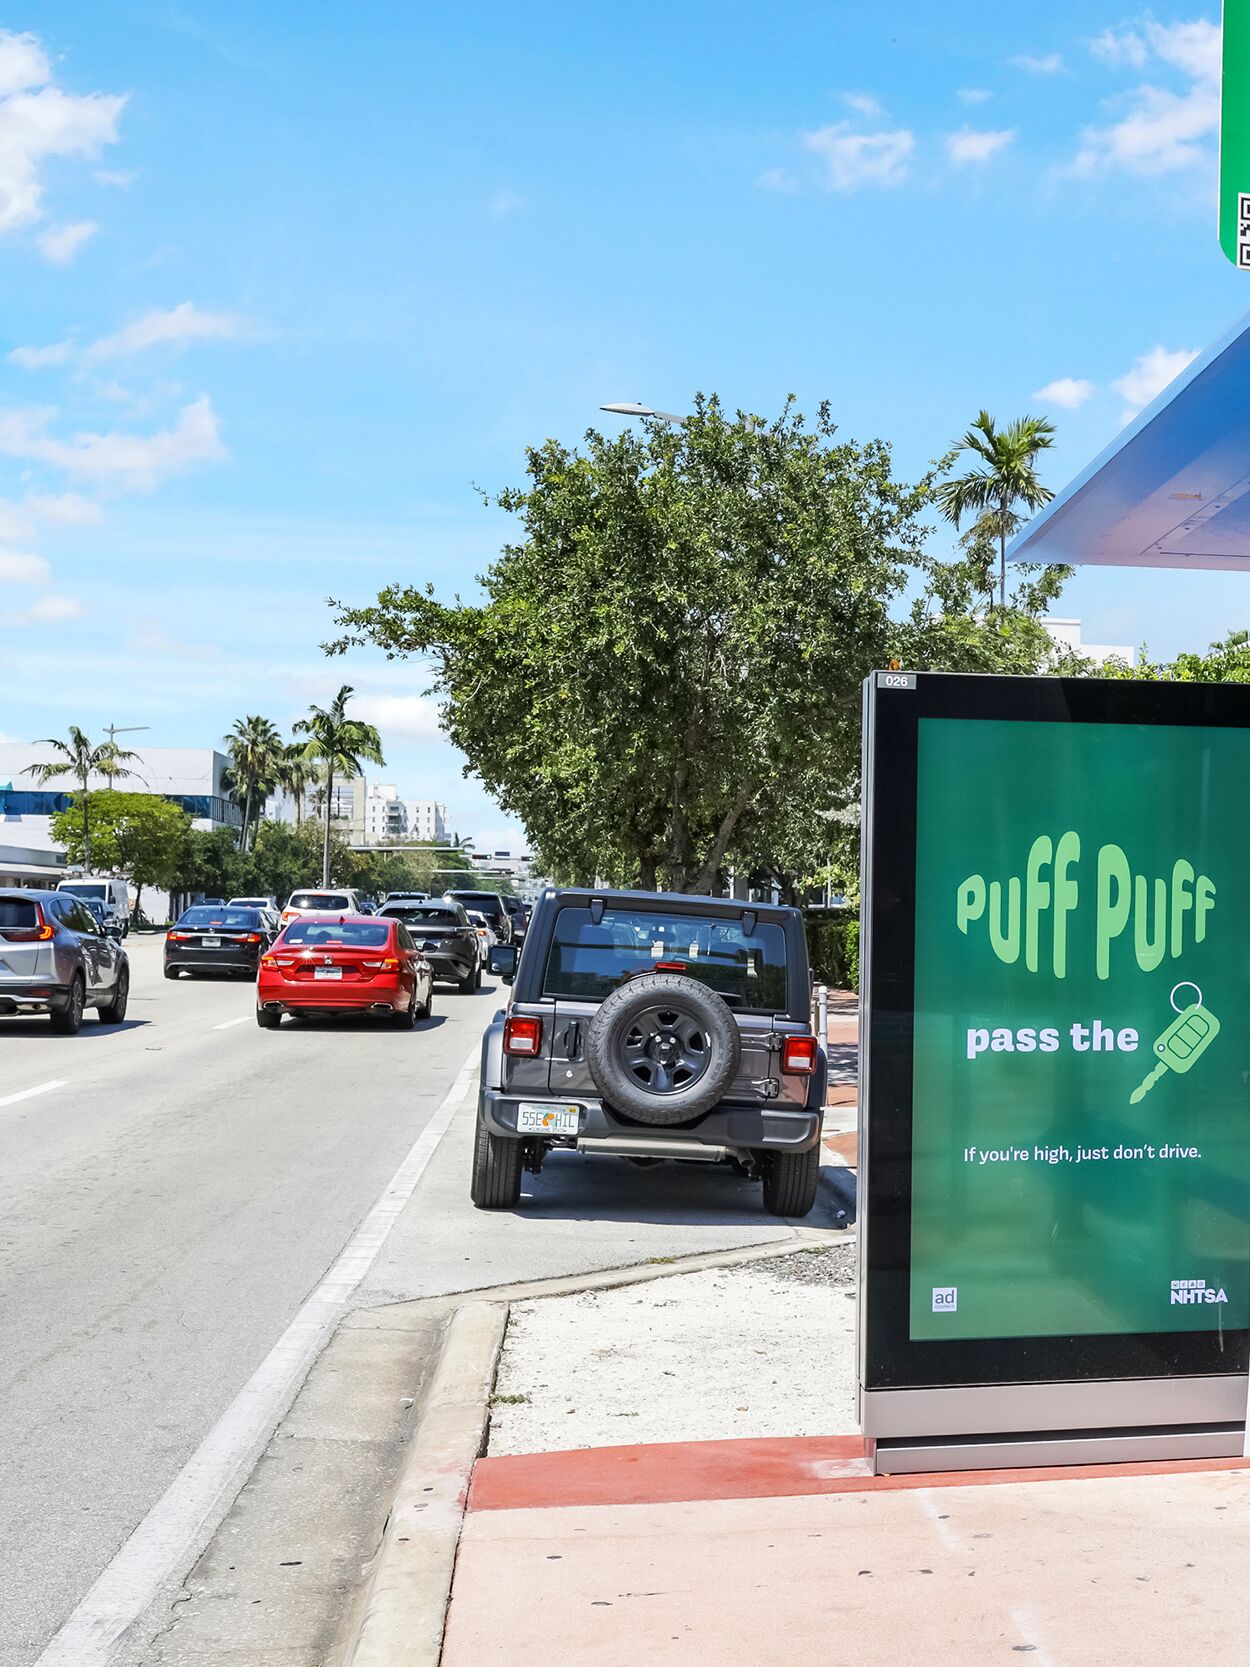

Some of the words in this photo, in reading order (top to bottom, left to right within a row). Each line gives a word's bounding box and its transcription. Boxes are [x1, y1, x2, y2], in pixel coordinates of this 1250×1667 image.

[885, 675, 908, 687] 026
[967, 1026, 1060, 1059] pass
[1070, 1020, 1139, 1052] the
[964, 1147, 977, 1162] If
[979, 1146, 1029, 1164] you're
[1034, 1145, 1073, 1164] high,
[1075, 1145, 1109, 1163] just
[1113, 1144, 1155, 1160] don't
[1159, 1143, 1201, 1159] drive.
[935, 1289, 955, 1304] ad
[1171, 1288, 1228, 1304] NHTSA
